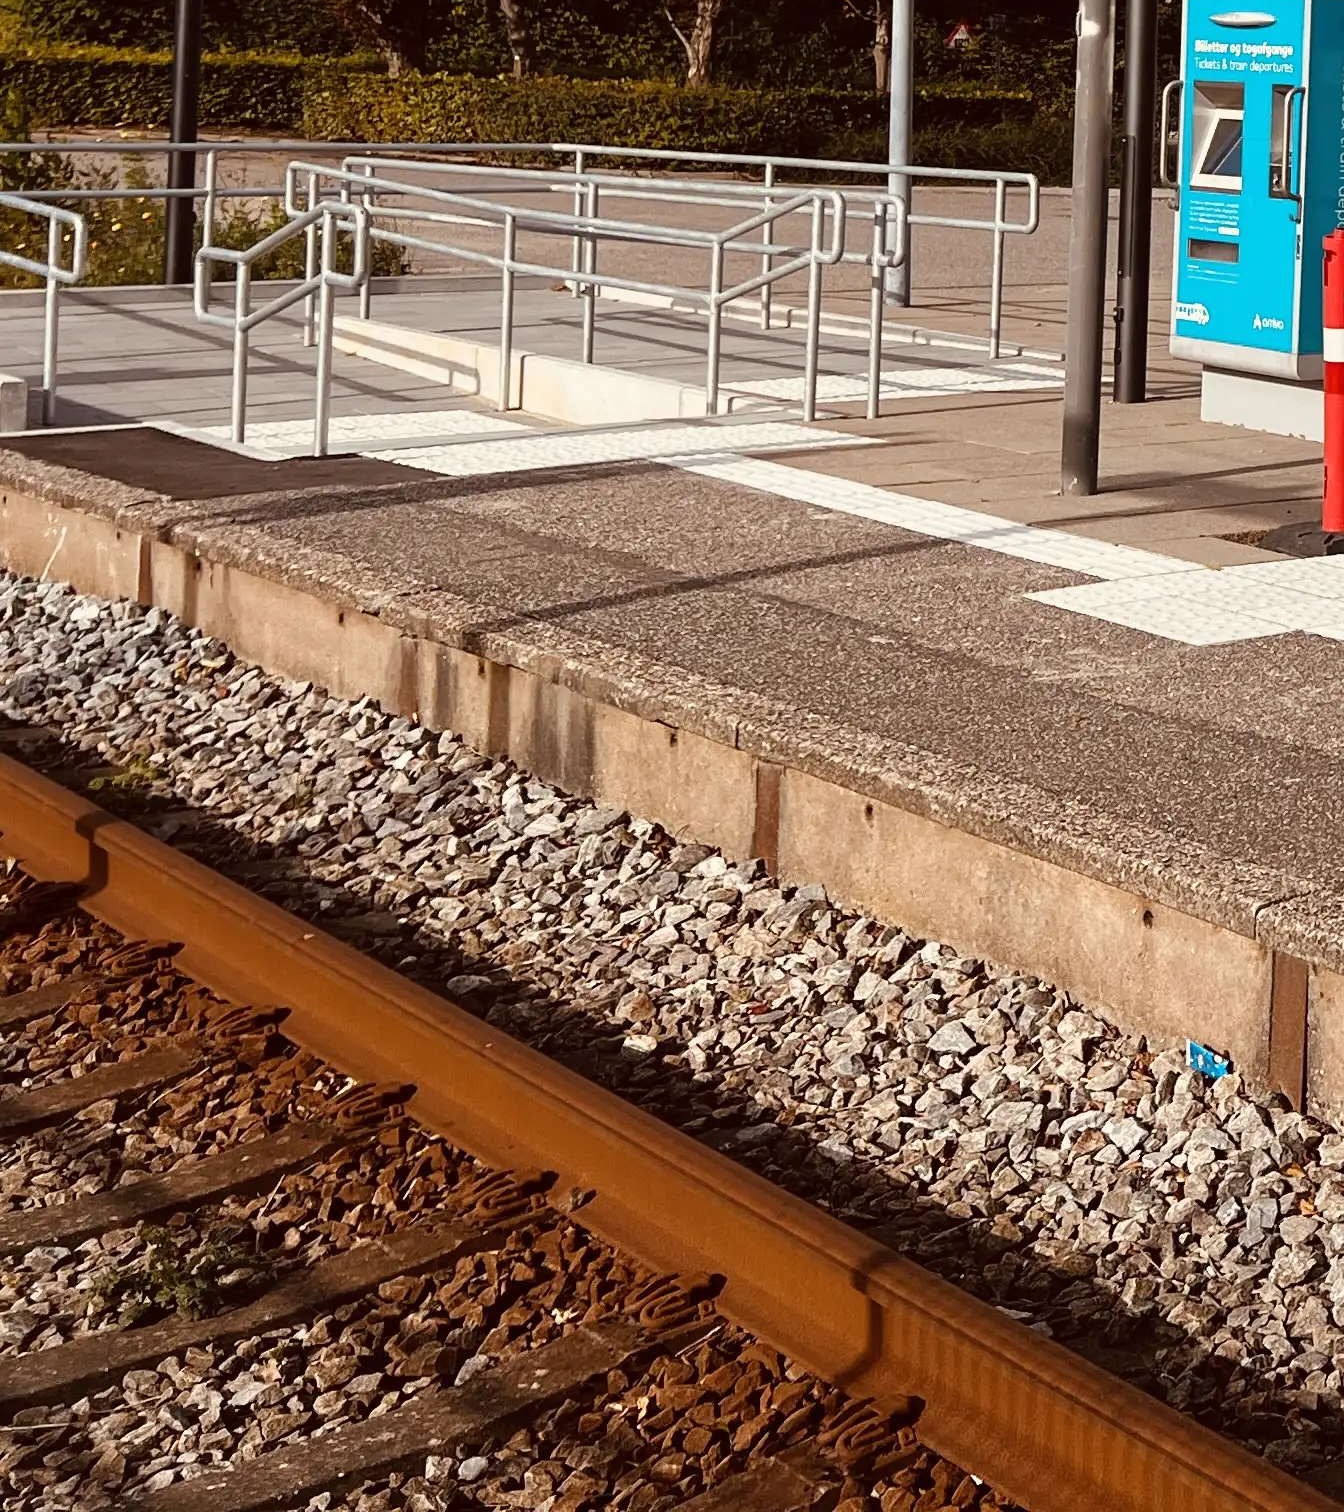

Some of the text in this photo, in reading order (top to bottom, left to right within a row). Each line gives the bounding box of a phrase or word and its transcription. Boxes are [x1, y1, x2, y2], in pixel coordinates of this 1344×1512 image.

[1229, 43, 1241, 57] og
[1194, 56, 1220, 70] Tickets
[1249, 60, 1294, 73] departures
